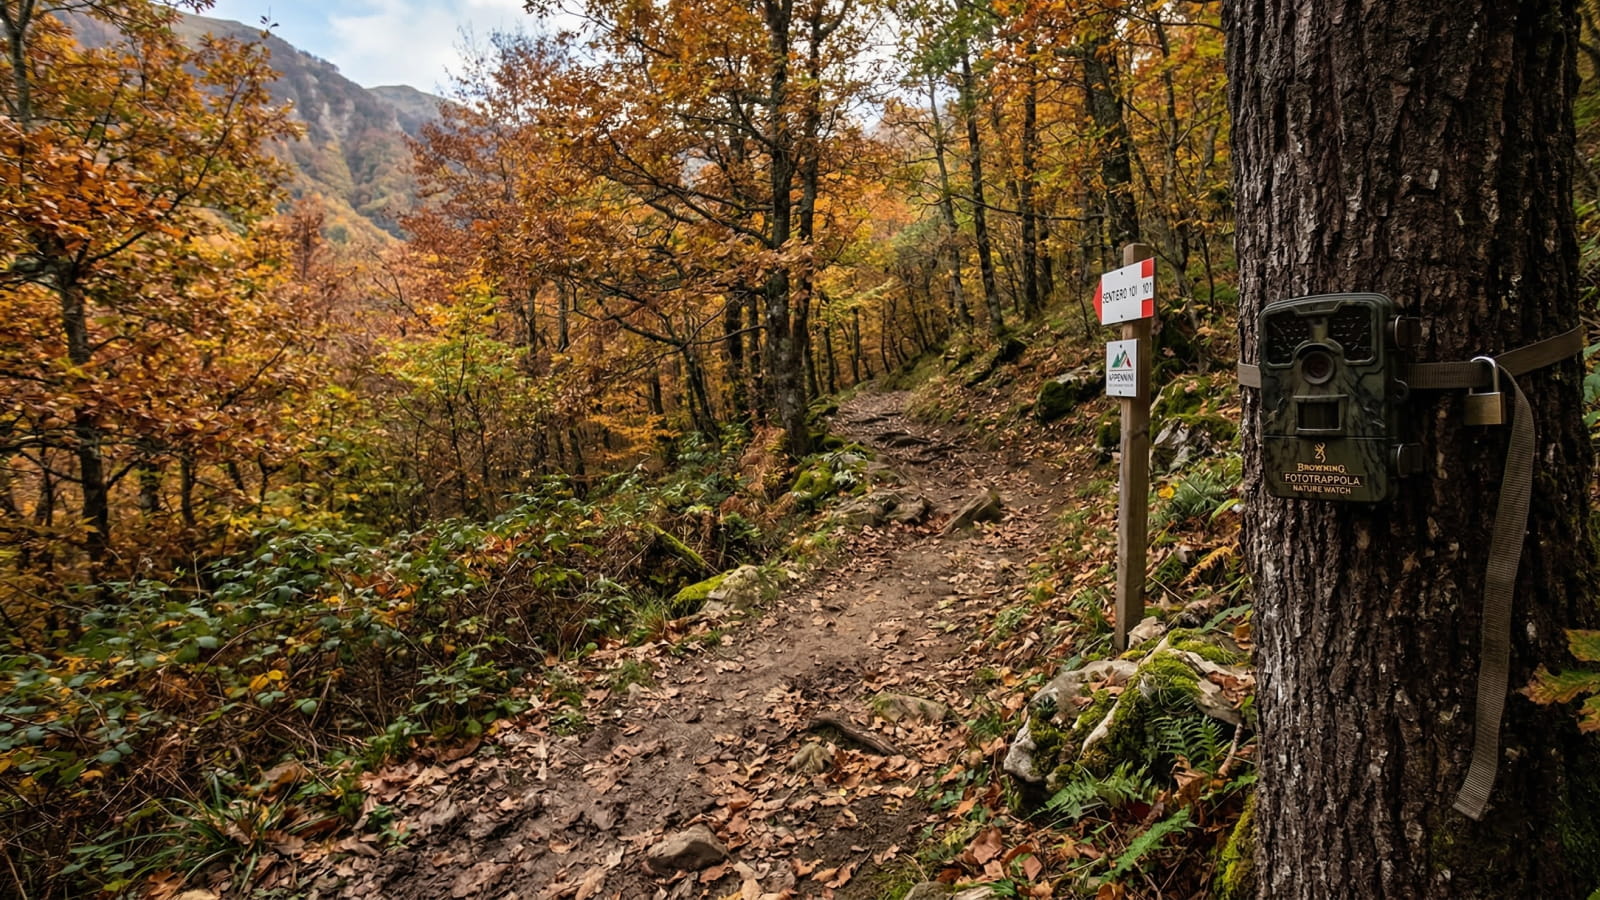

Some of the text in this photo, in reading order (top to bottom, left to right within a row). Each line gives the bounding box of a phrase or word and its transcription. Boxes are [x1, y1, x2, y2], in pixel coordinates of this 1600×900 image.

[1284, 473, 1361, 486] FOTOTRAPPOLA
[1293, 484, 1352, 495] NATURE WATCH
